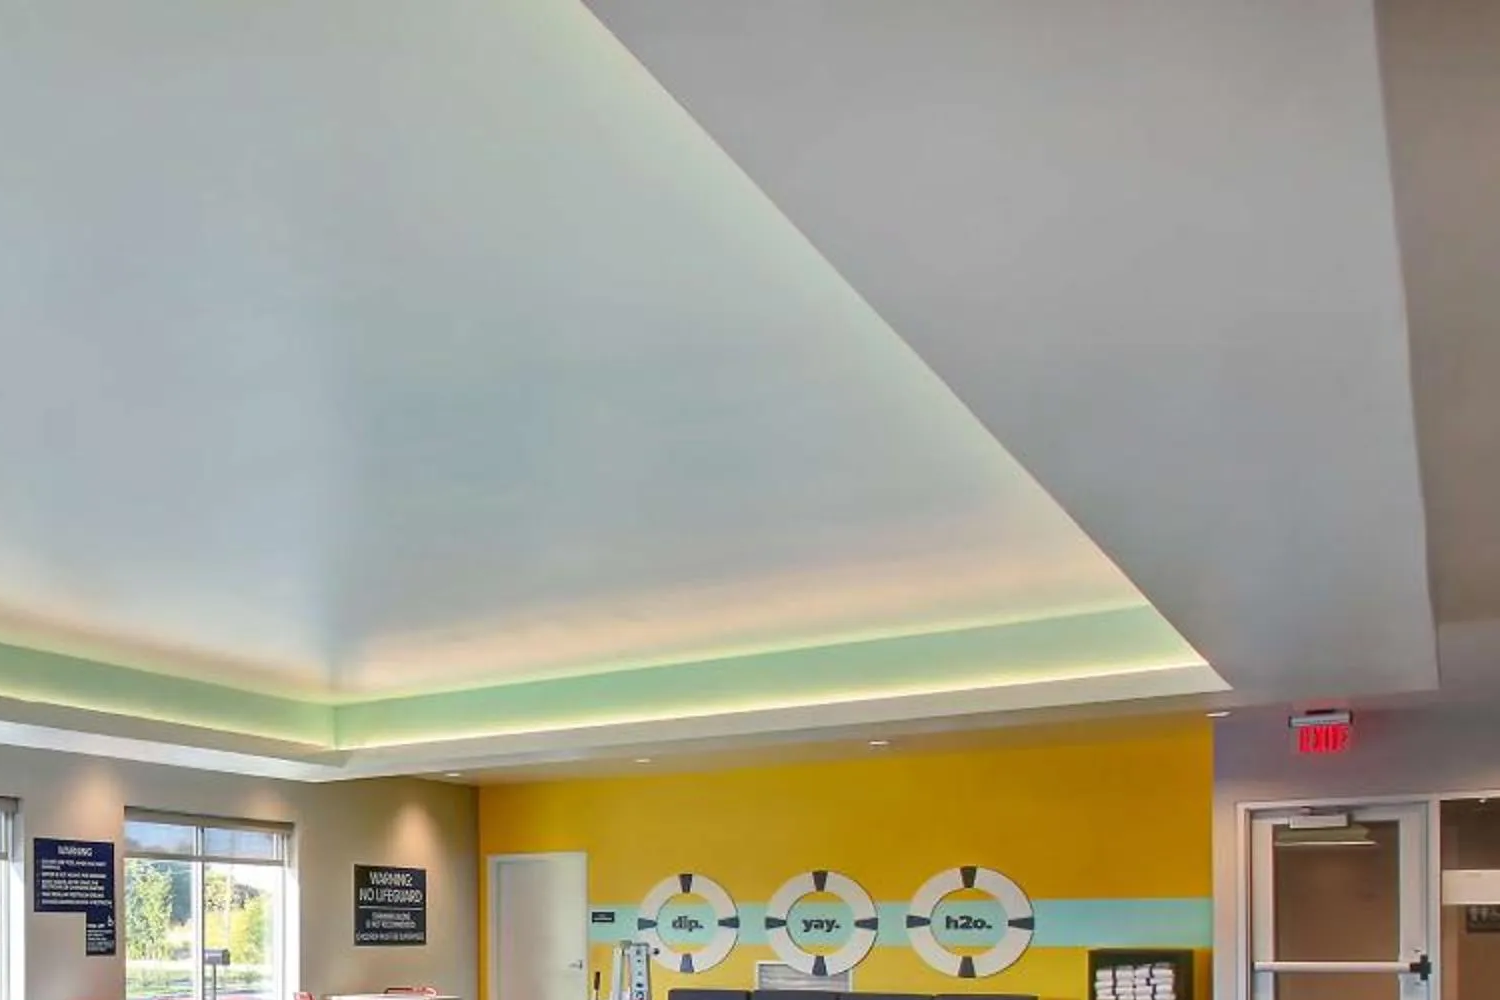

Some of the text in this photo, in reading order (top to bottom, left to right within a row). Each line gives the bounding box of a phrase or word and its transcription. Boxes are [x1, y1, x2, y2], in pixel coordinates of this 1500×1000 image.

[1299, 726, 1350, 752] EXIT
[359, 887, 423, 903] NO LIFEGUARD
[801, 917, 841, 932] yay.
[944, 914, 993, 930] h2o.
